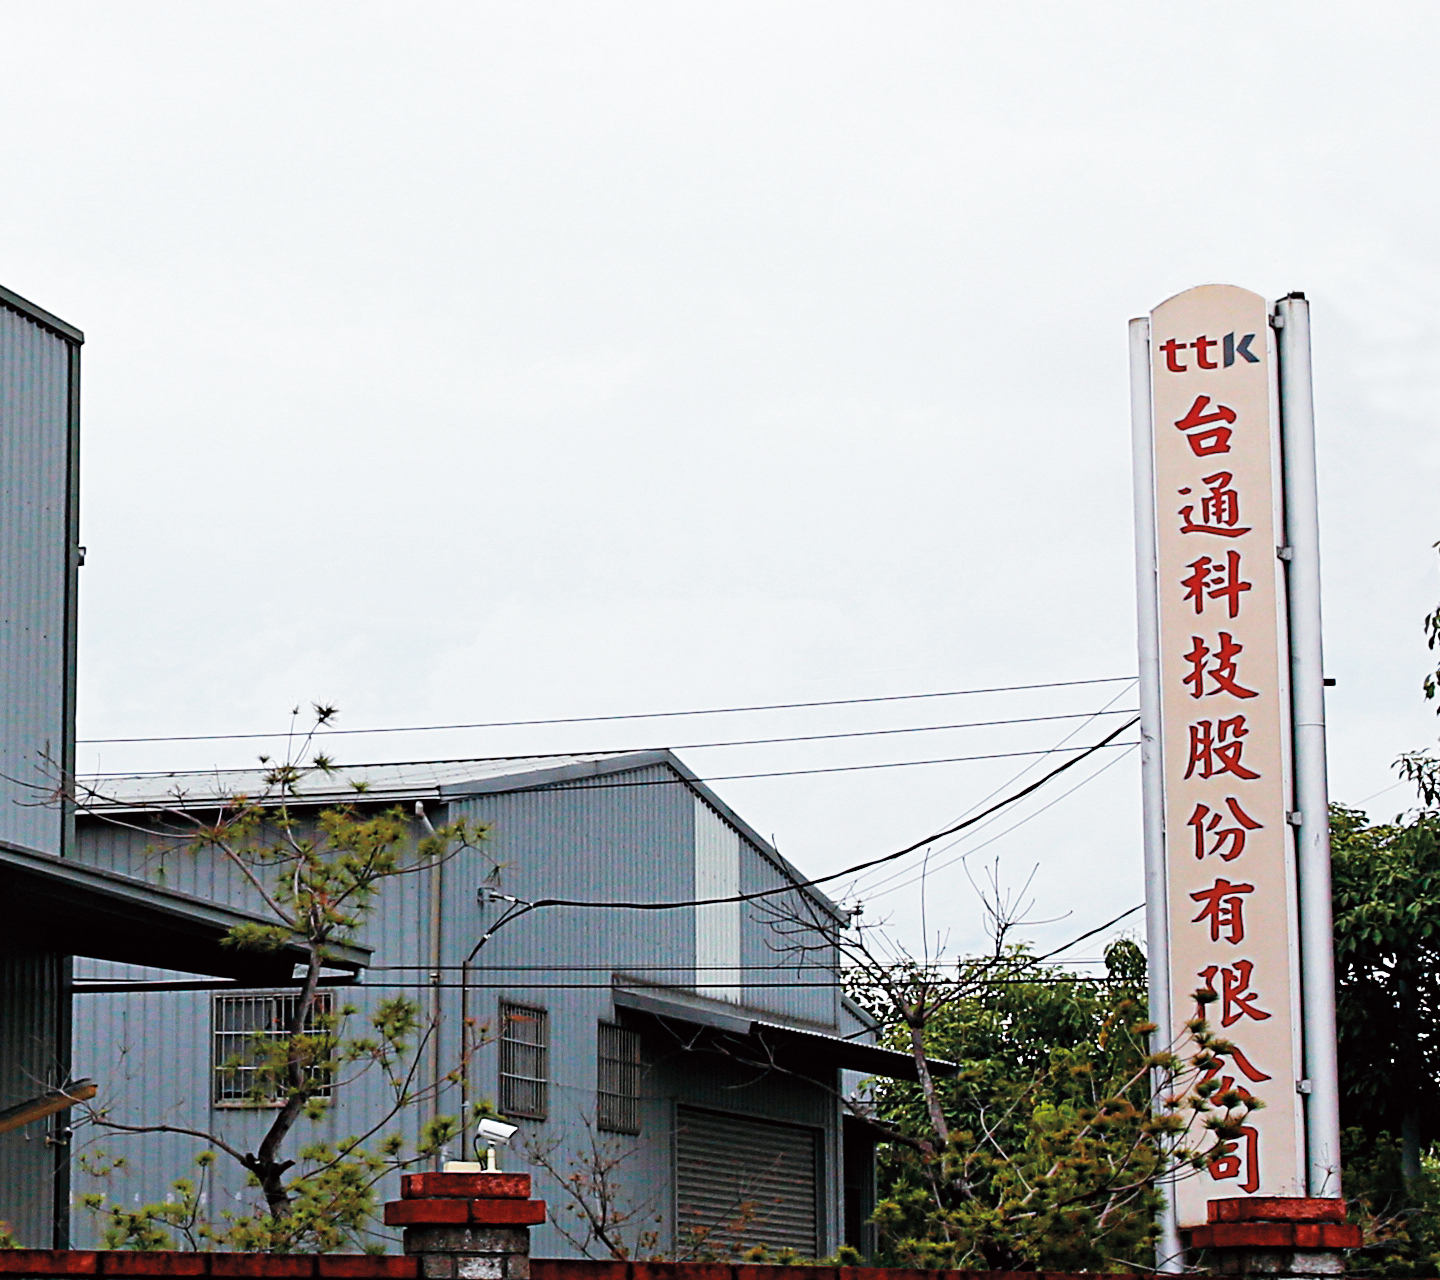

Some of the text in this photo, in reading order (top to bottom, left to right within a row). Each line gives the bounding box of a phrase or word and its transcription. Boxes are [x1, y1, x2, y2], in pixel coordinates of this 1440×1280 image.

[1175, 395, 1272, 1194] 台通科技股份有限公司
